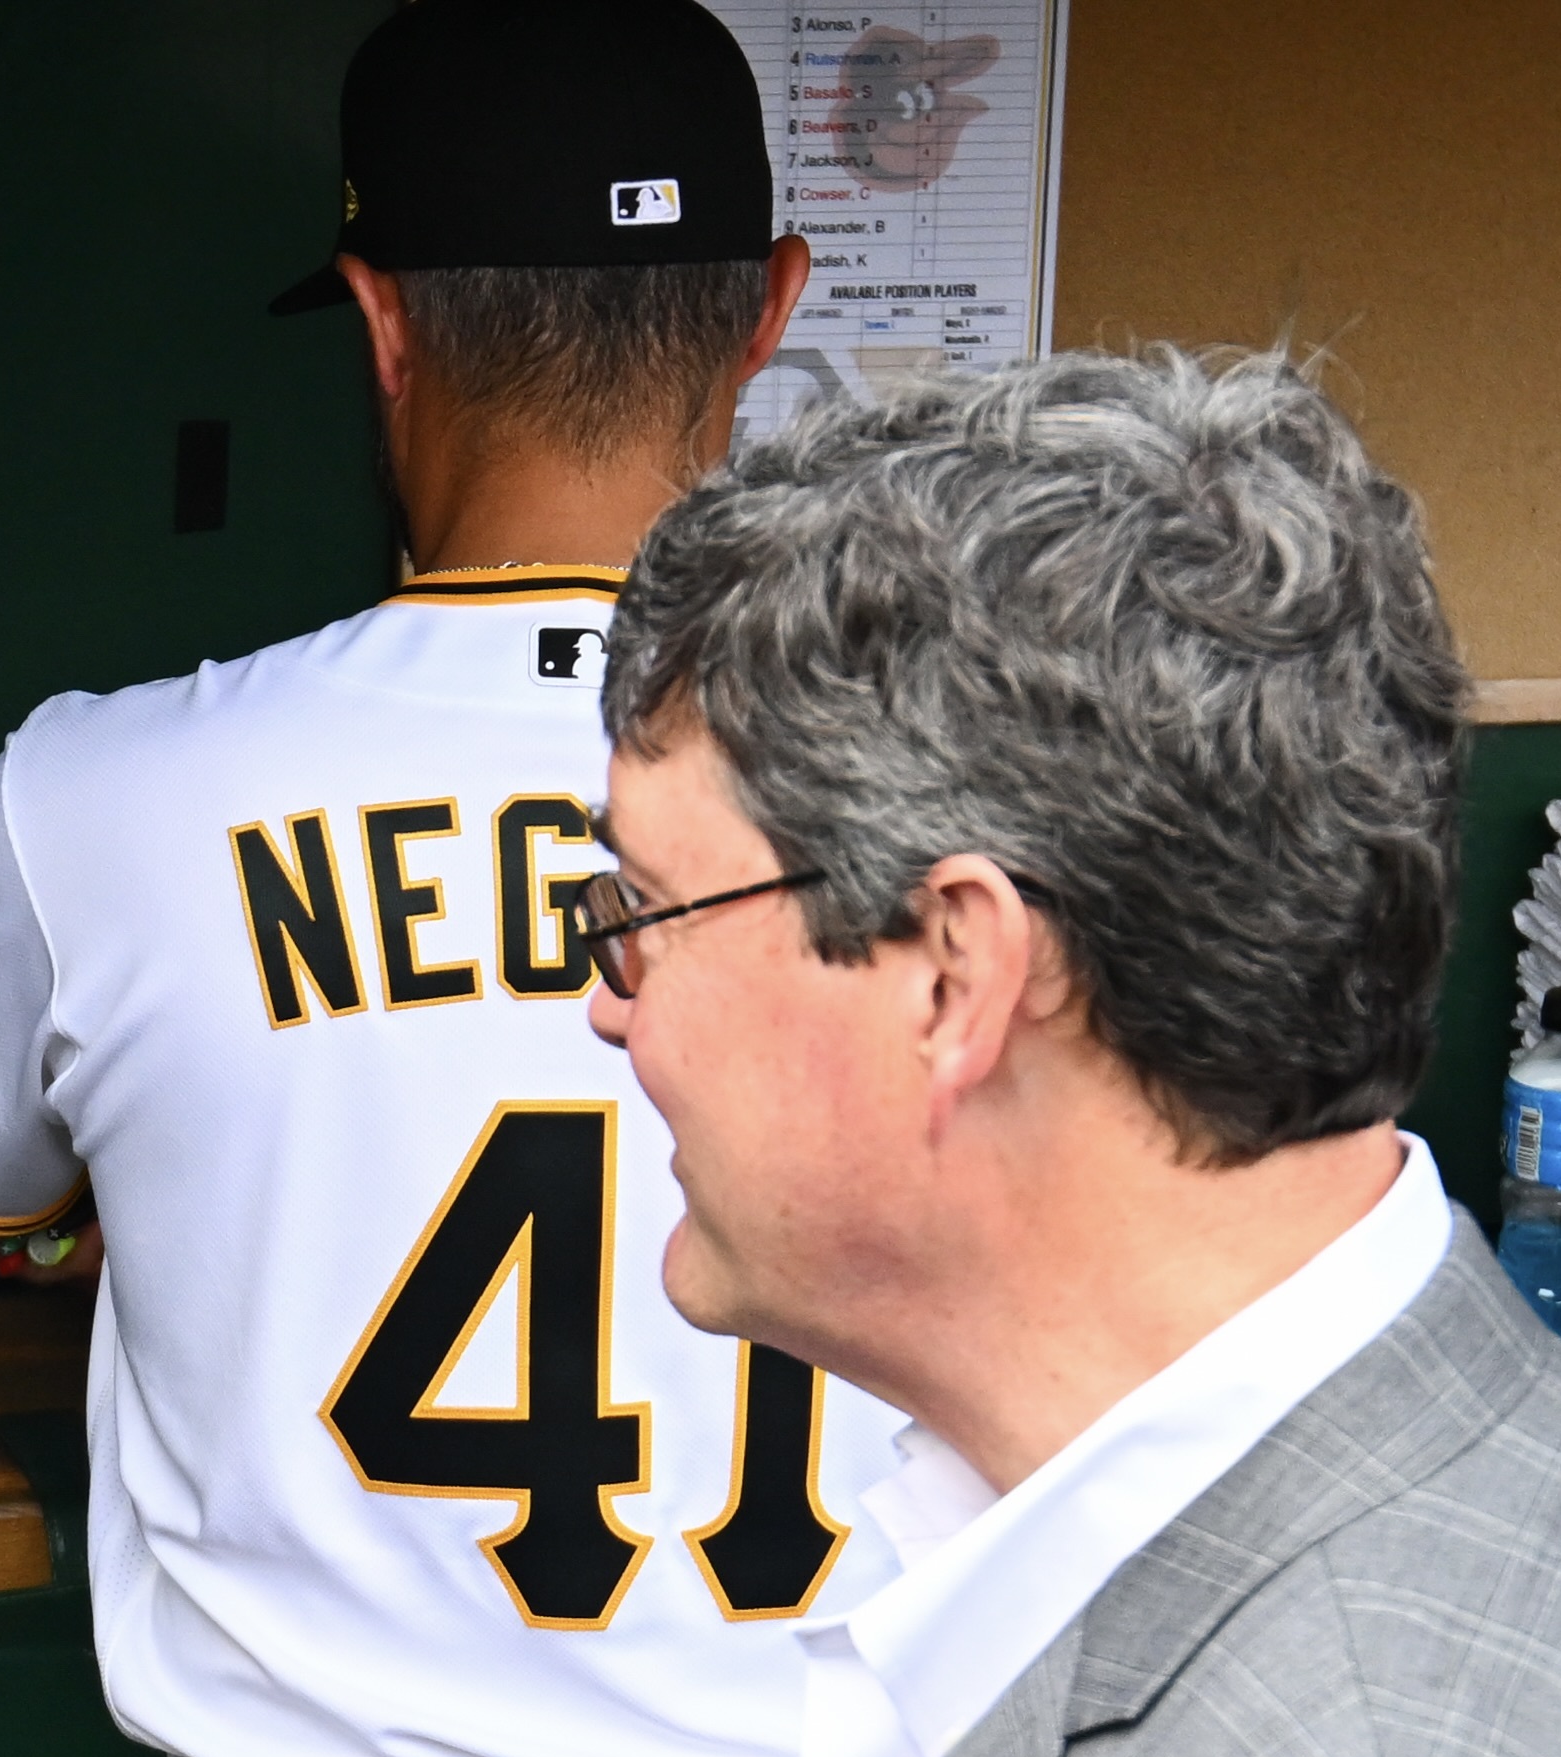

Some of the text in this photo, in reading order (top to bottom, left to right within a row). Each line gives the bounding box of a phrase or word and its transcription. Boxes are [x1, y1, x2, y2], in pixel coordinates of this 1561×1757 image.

[792, 16, 872, 33] 3 Alonso, P
[790, 51, 799, 67] 4
[789, 85, 799, 101] 5
[788, 118, 798, 135] 6
[866, 119, 878, 133] D
[787, 153, 797, 169] 7
[800, 154, 861, 168] Jackson,
[786, 186, 795, 202] 8
[860, 187, 871, 200] C
[798, 221, 871, 235] Alexander,
[875, 220, 886, 234] B
[856, 254, 868, 267] K
[830, 284, 977, 300] AVAILABLE POSITION PLAYERS
[317, 1099, 852, 1631] 41
